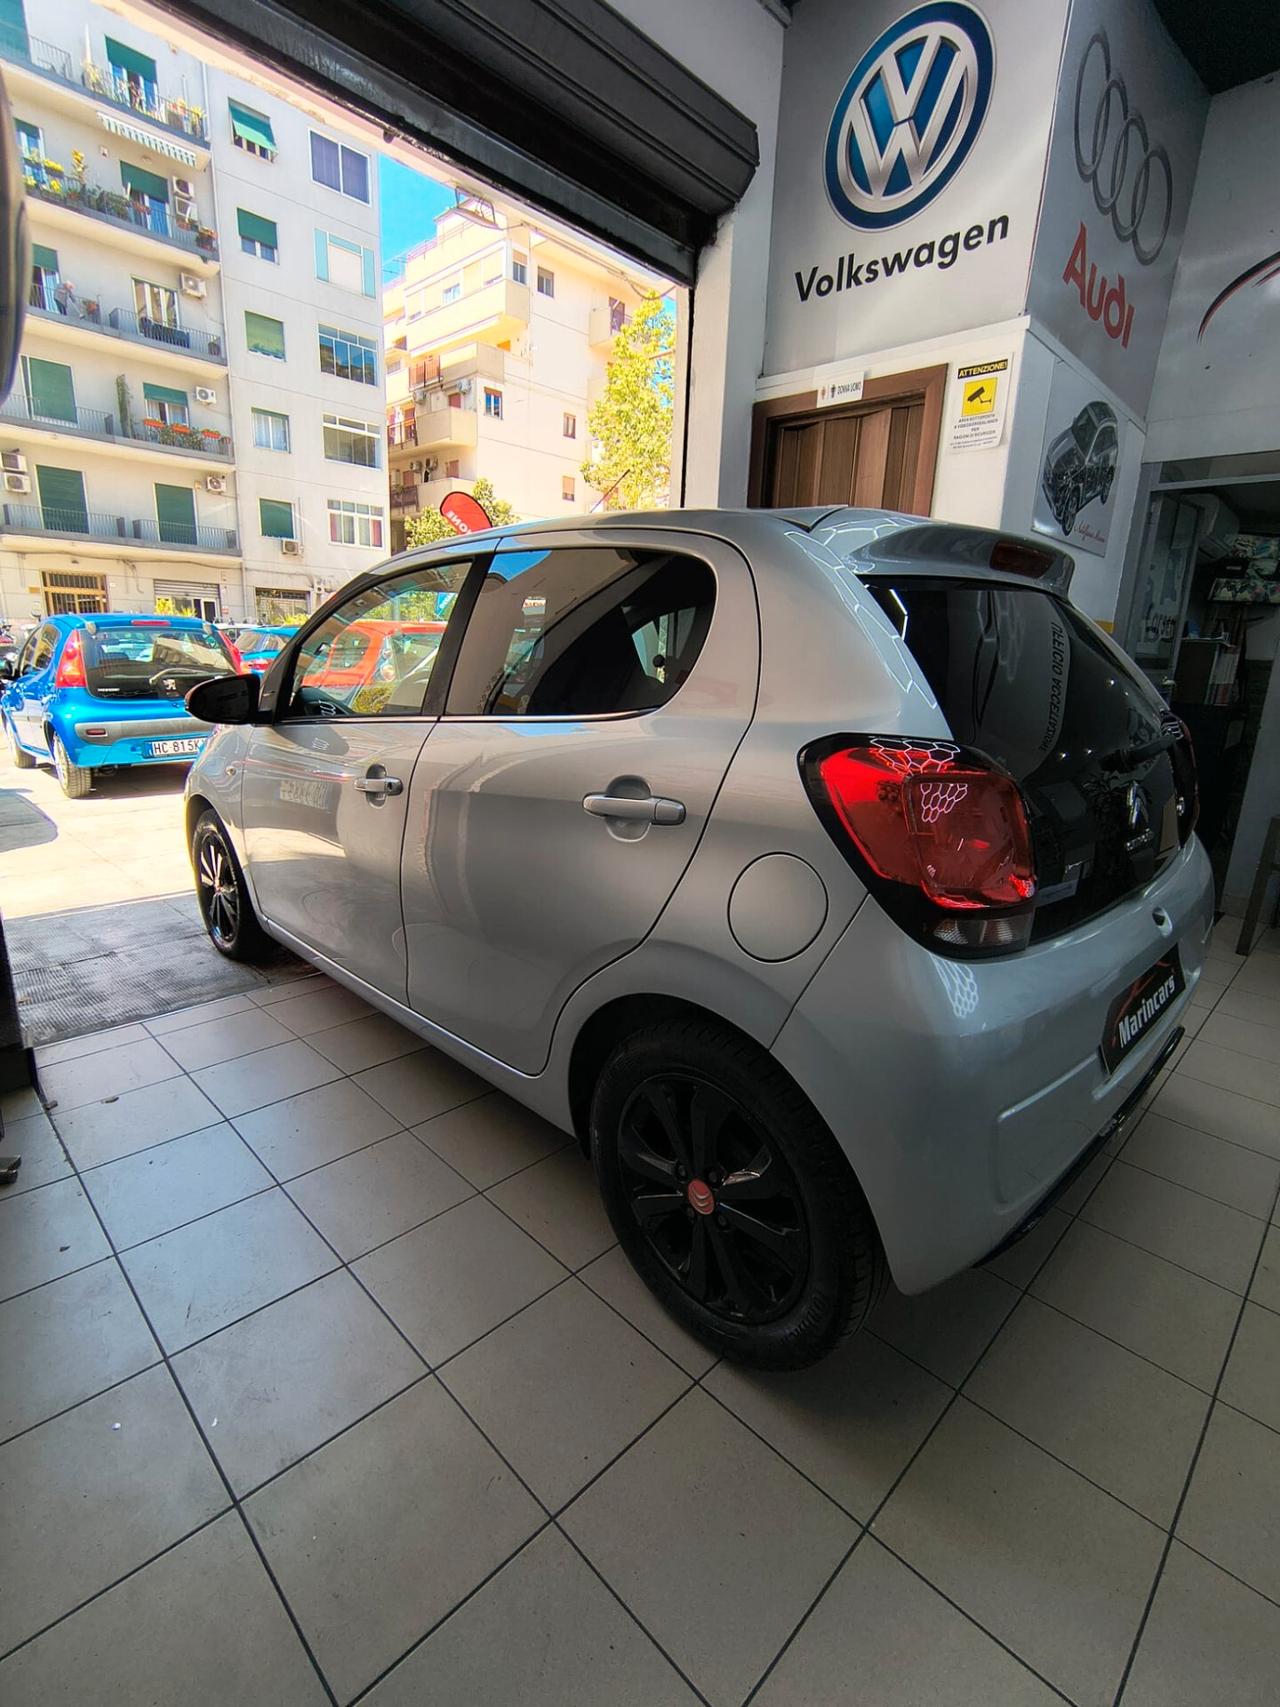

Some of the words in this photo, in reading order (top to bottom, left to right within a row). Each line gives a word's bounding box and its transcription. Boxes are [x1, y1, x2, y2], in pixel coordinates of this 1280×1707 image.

[794, 214, 1010, 302] Volkswagen
[1062, 221, 1135, 350] Audi
[958, 361, 1007, 377] ATTENZIONE!
[153, 742, 169, 754] HC
[1118, 974, 1176, 1049] Marincars
